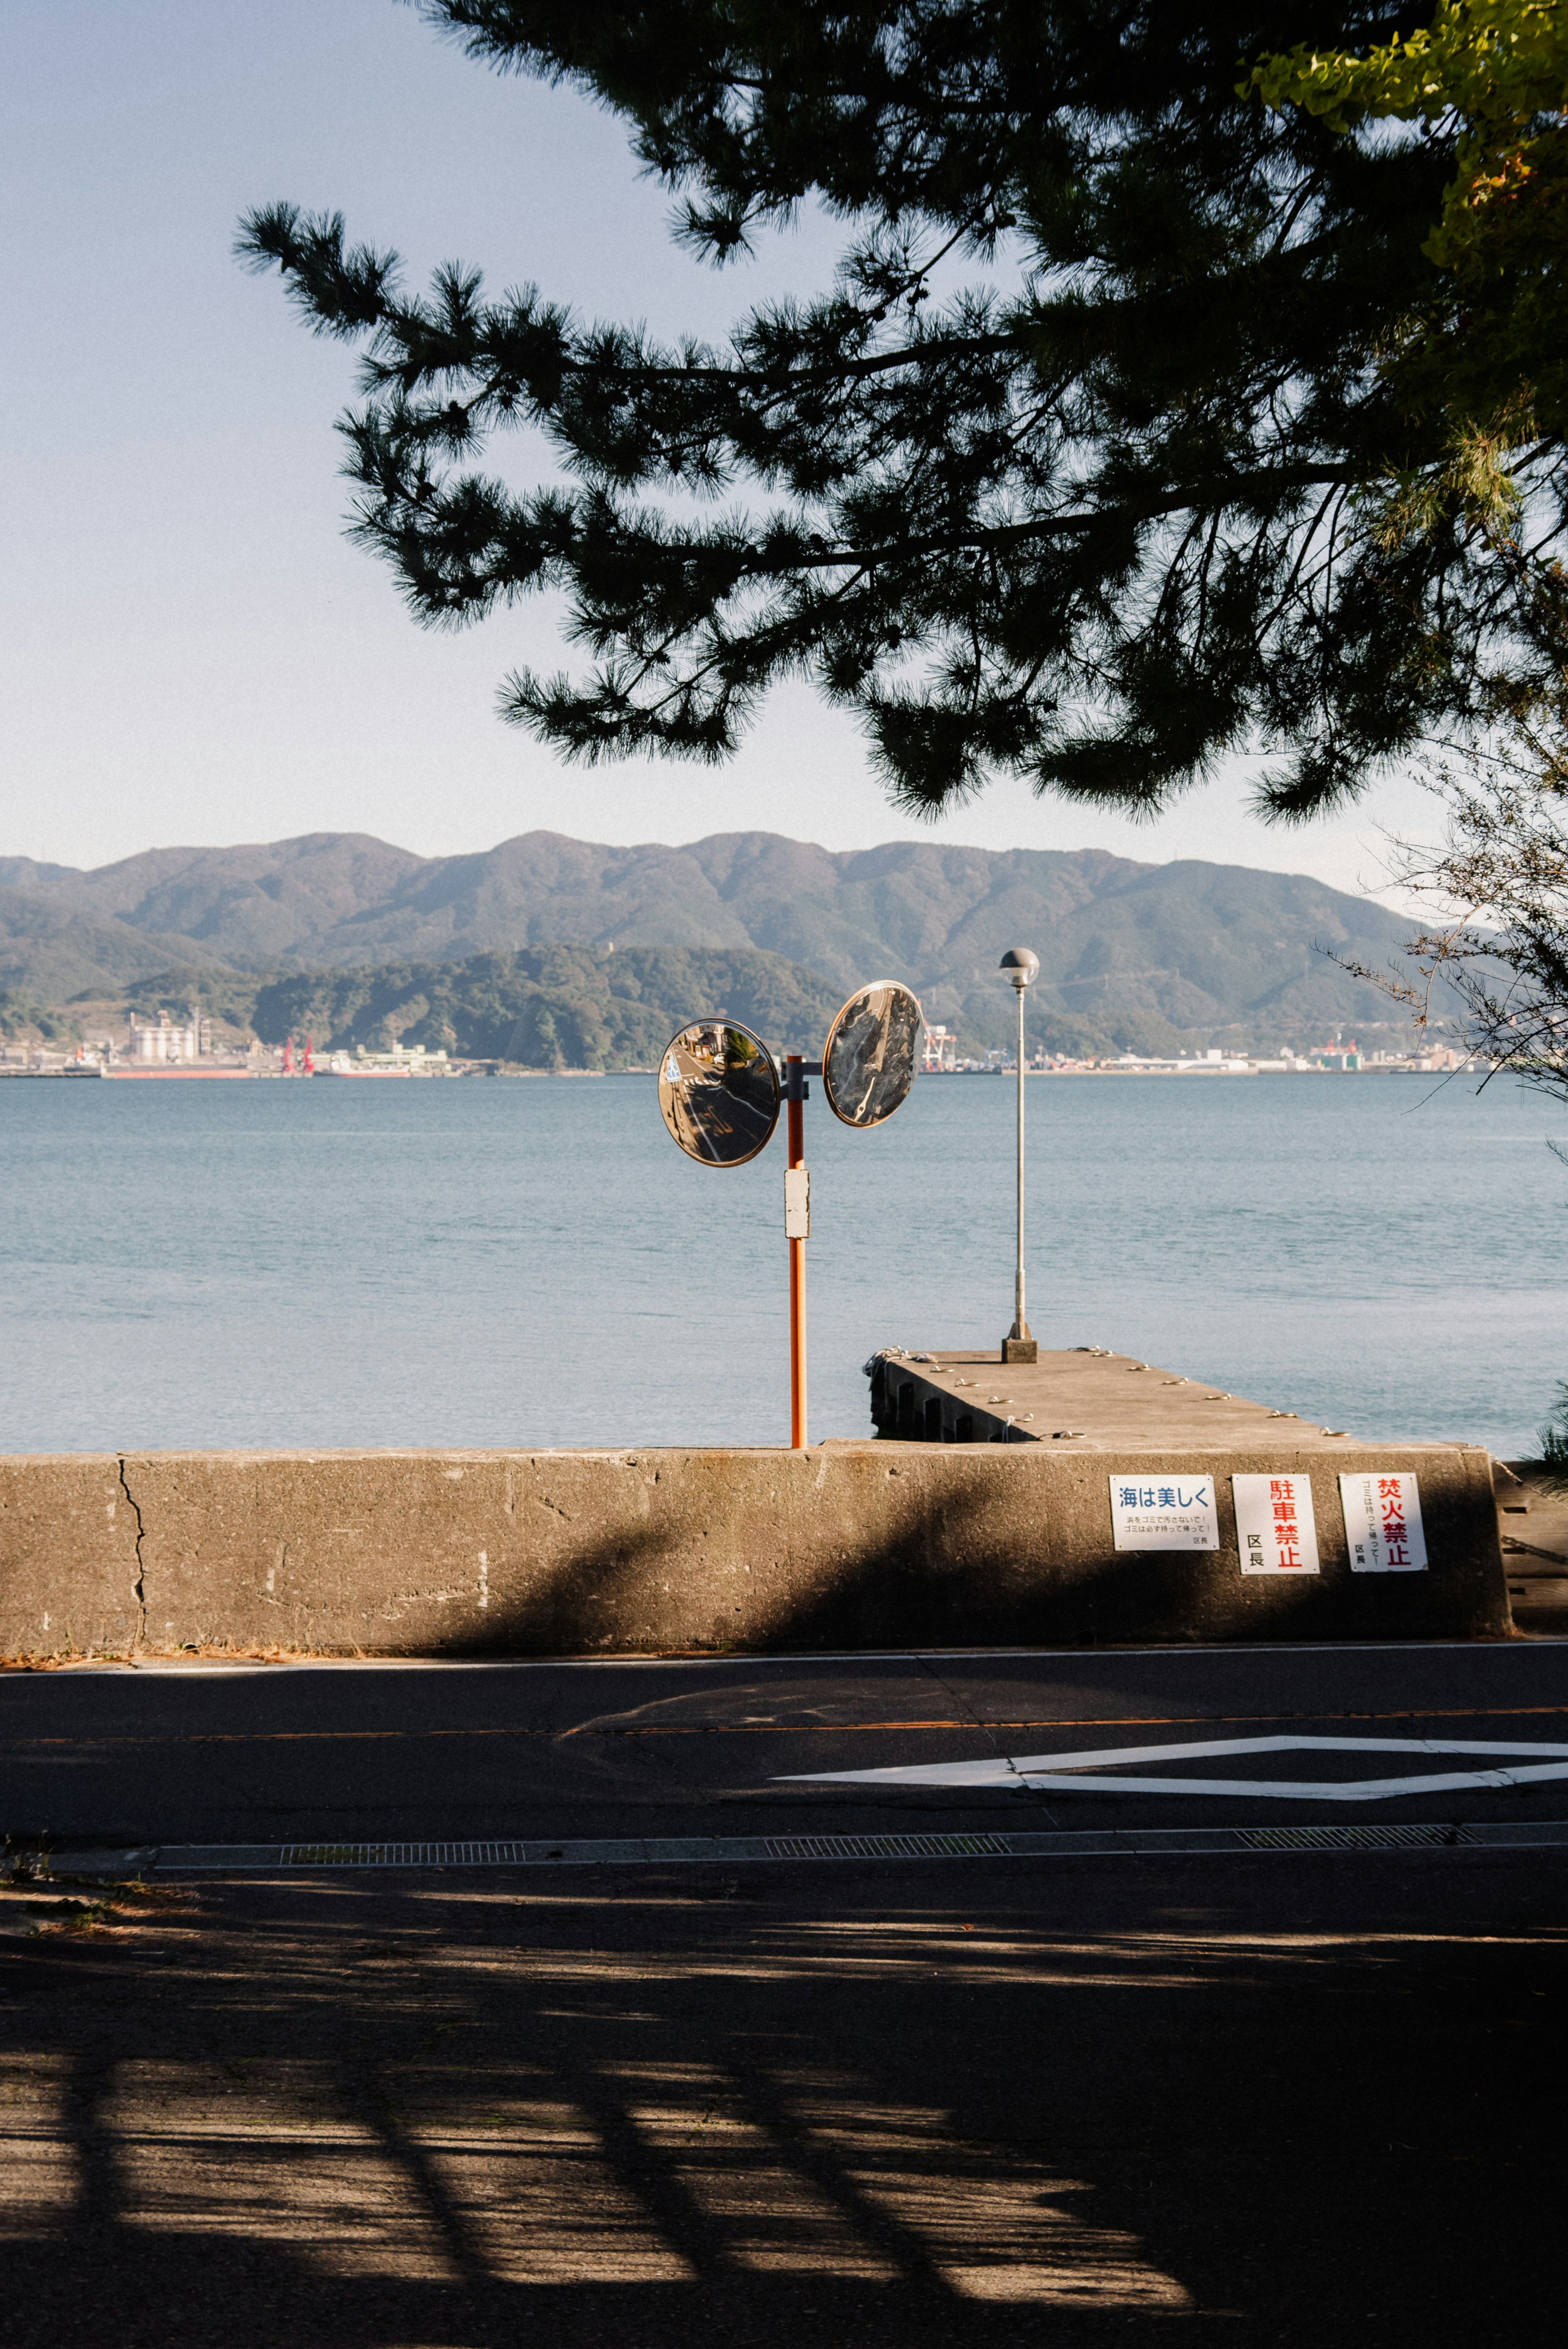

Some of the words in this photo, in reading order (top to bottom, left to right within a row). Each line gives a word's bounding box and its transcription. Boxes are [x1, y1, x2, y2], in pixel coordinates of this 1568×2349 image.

[1119, 1487, 1209, 1507] 海は美しく
[1270, 1480, 1302, 1567] 駐車禁止
[1378, 1478, 1412, 1565] 焚火禁止
[1247, 1535, 1264, 1566] 区長
[1355, 1545, 1366, 1564] 区長
